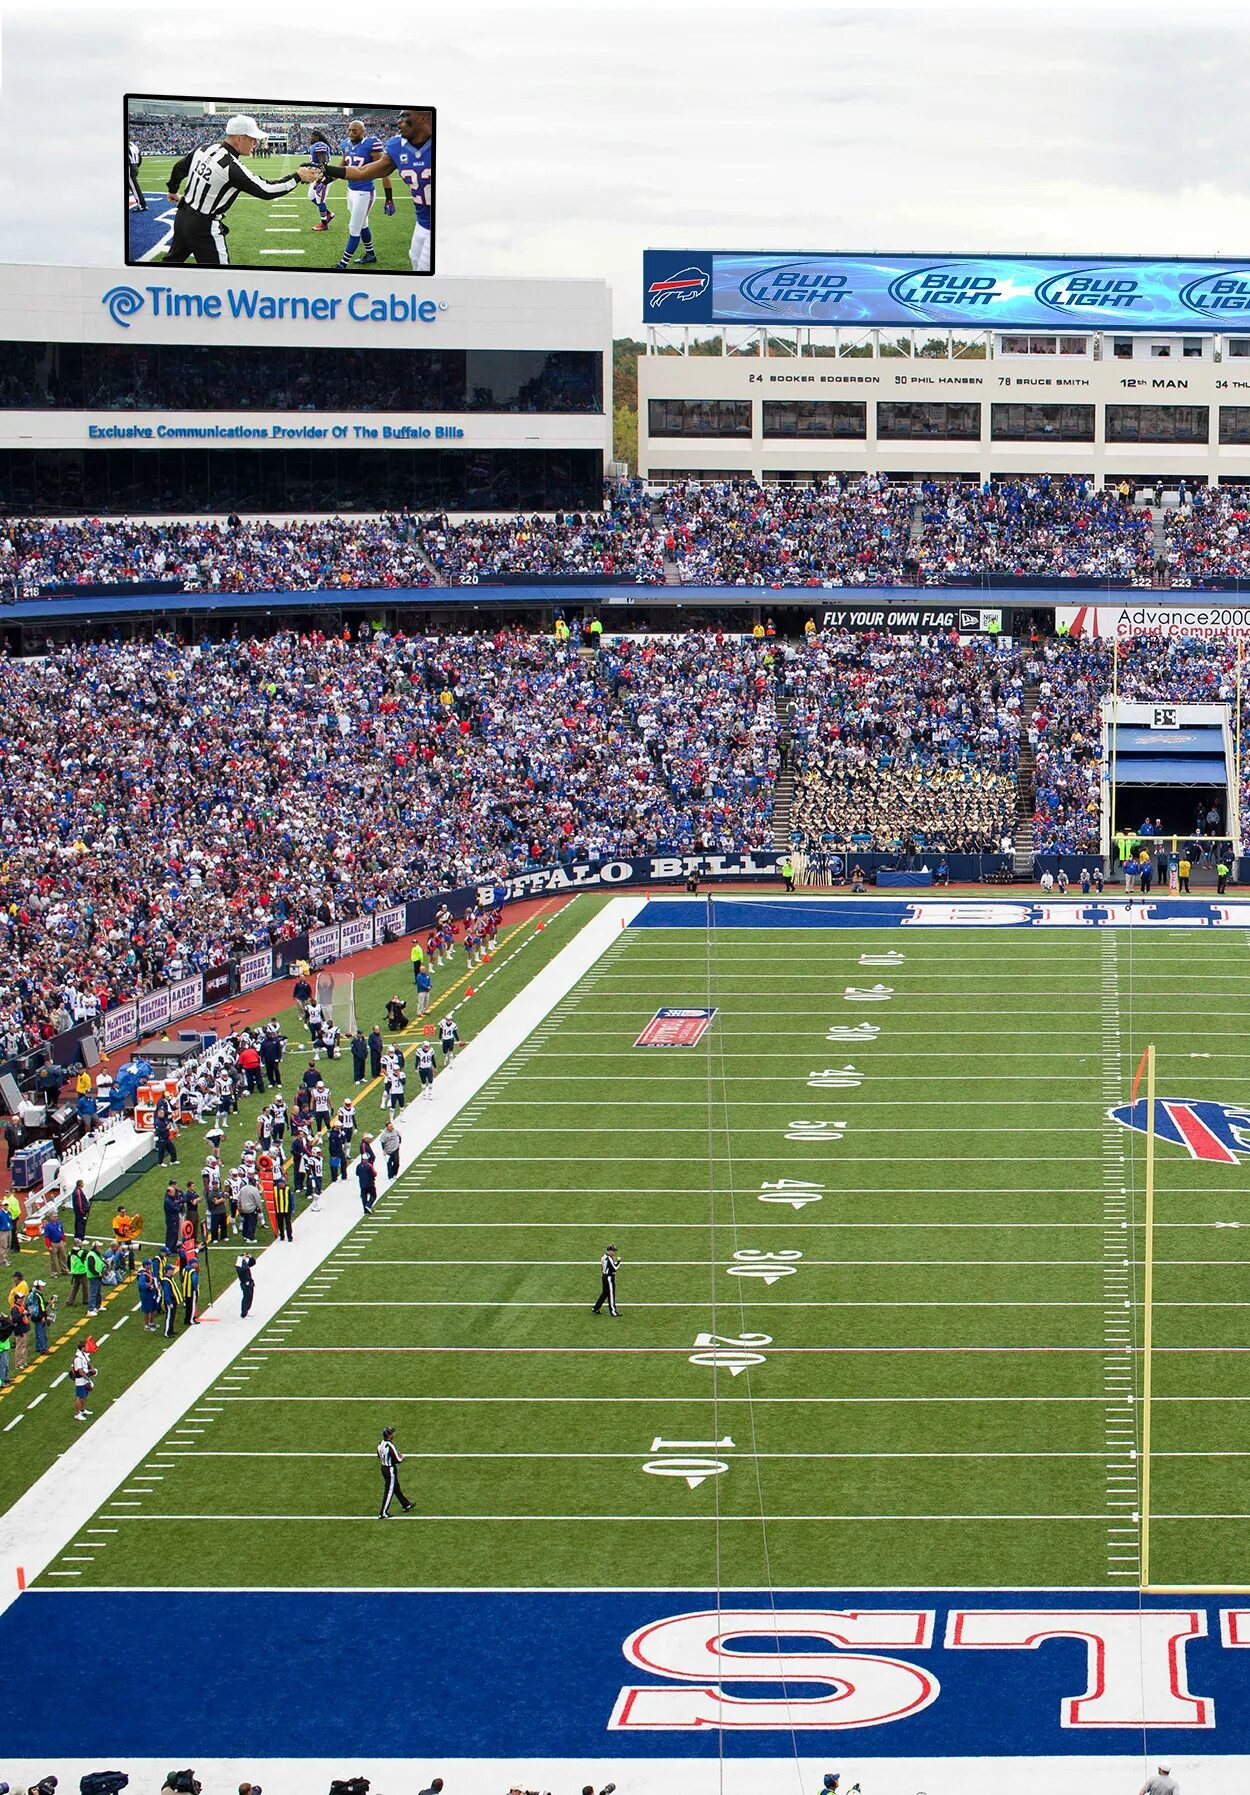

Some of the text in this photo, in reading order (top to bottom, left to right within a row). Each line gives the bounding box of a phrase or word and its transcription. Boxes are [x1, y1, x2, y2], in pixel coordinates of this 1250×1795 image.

[194, 160, 211, 182] 132
[773, 272, 848, 287] BUD
[921, 274, 996, 289] BUD
[1065, 277, 1139, 292] BUD
[757, 288, 853, 303] LIGHT
[903, 290, 1001, 305] LIGHT
[1051, 291, 1143, 307] LIGHT
[145, 286, 437, 323] Time Warner Cable
[749, 374, 881, 384] 24 BOOKER EDGERSON
[894, 375, 908, 385] 90
[997, 377, 1012, 386] 78
[1016, 378, 1052, 386] BRUCE
[1119, 378, 1189, 389] 12th MAN
[1215, 380, 1229, 389] 34
[88, 425, 465, 438] Exclusive Communications Provider Of The Buffalo Bills
[1131, 577, 1152, 588] 222
[1171, 577, 1193, 588] 223
[823, 611, 954, 627] FLY YOUR OWN FLAG
[1117, 623, 1168, 638] Cloud
[1155, 709, 1177, 726] 34
[478, 853, 792, 907] BUFFALO BILLS
[171, 982, 202, 1002] AARON'S
[178, 994, 196, 1011] ACES
[784, 1119, 848, 1141] 50
[758, 1178, 825, 1204] 40
[726, 1249, 803, 1278] 30
[689, 1332, 773, 1367] 20
[642, 1435, 736, 1477] 10
